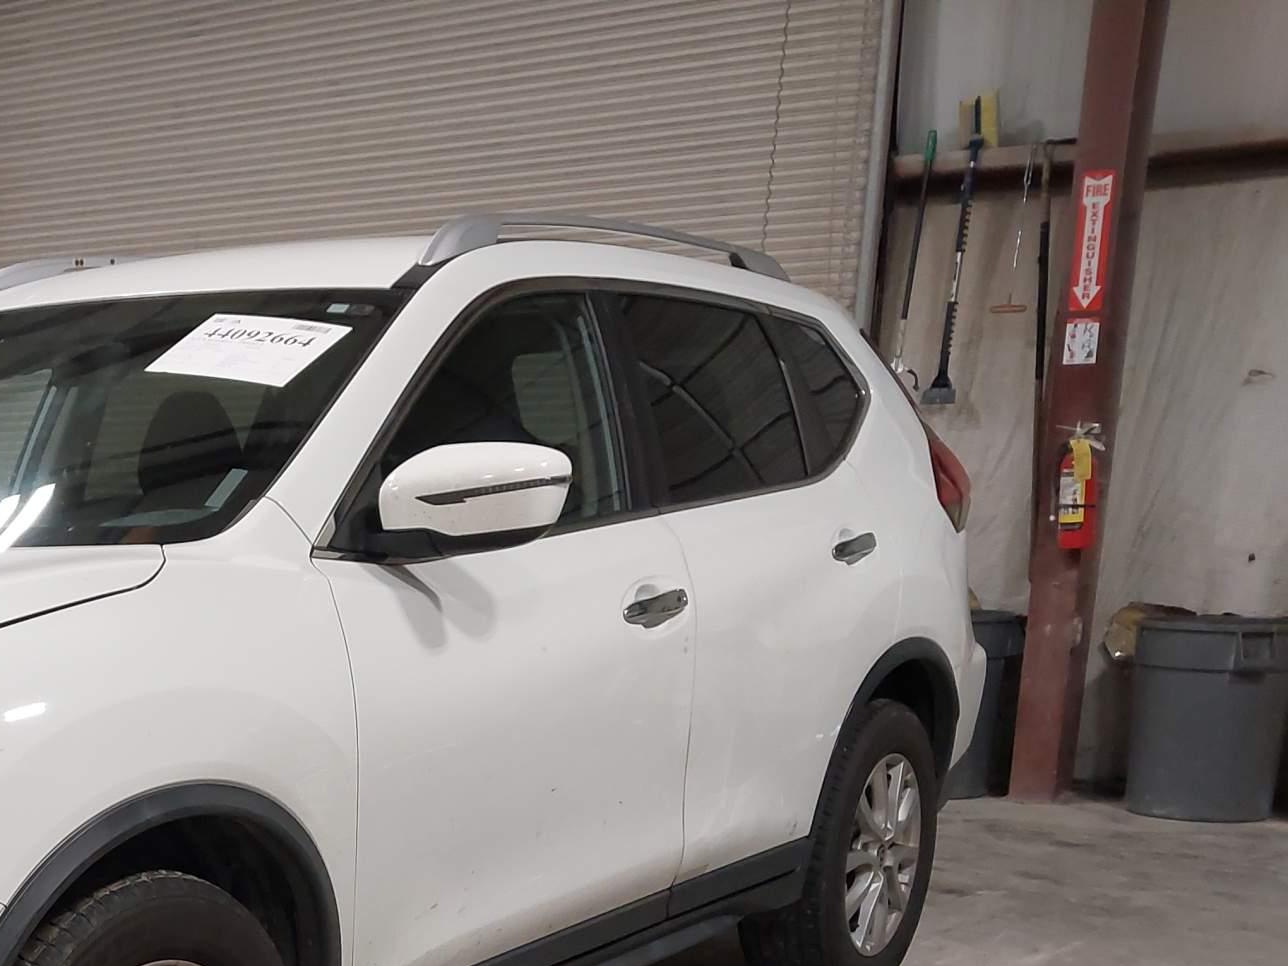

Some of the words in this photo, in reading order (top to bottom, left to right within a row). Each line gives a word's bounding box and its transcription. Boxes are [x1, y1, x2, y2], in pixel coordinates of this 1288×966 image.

[1085, 184, 1110, 198] FIRE
[1081, 201, 1100, 300] EXTINGUISHER
[203, 327, 317, 348] 44092664
